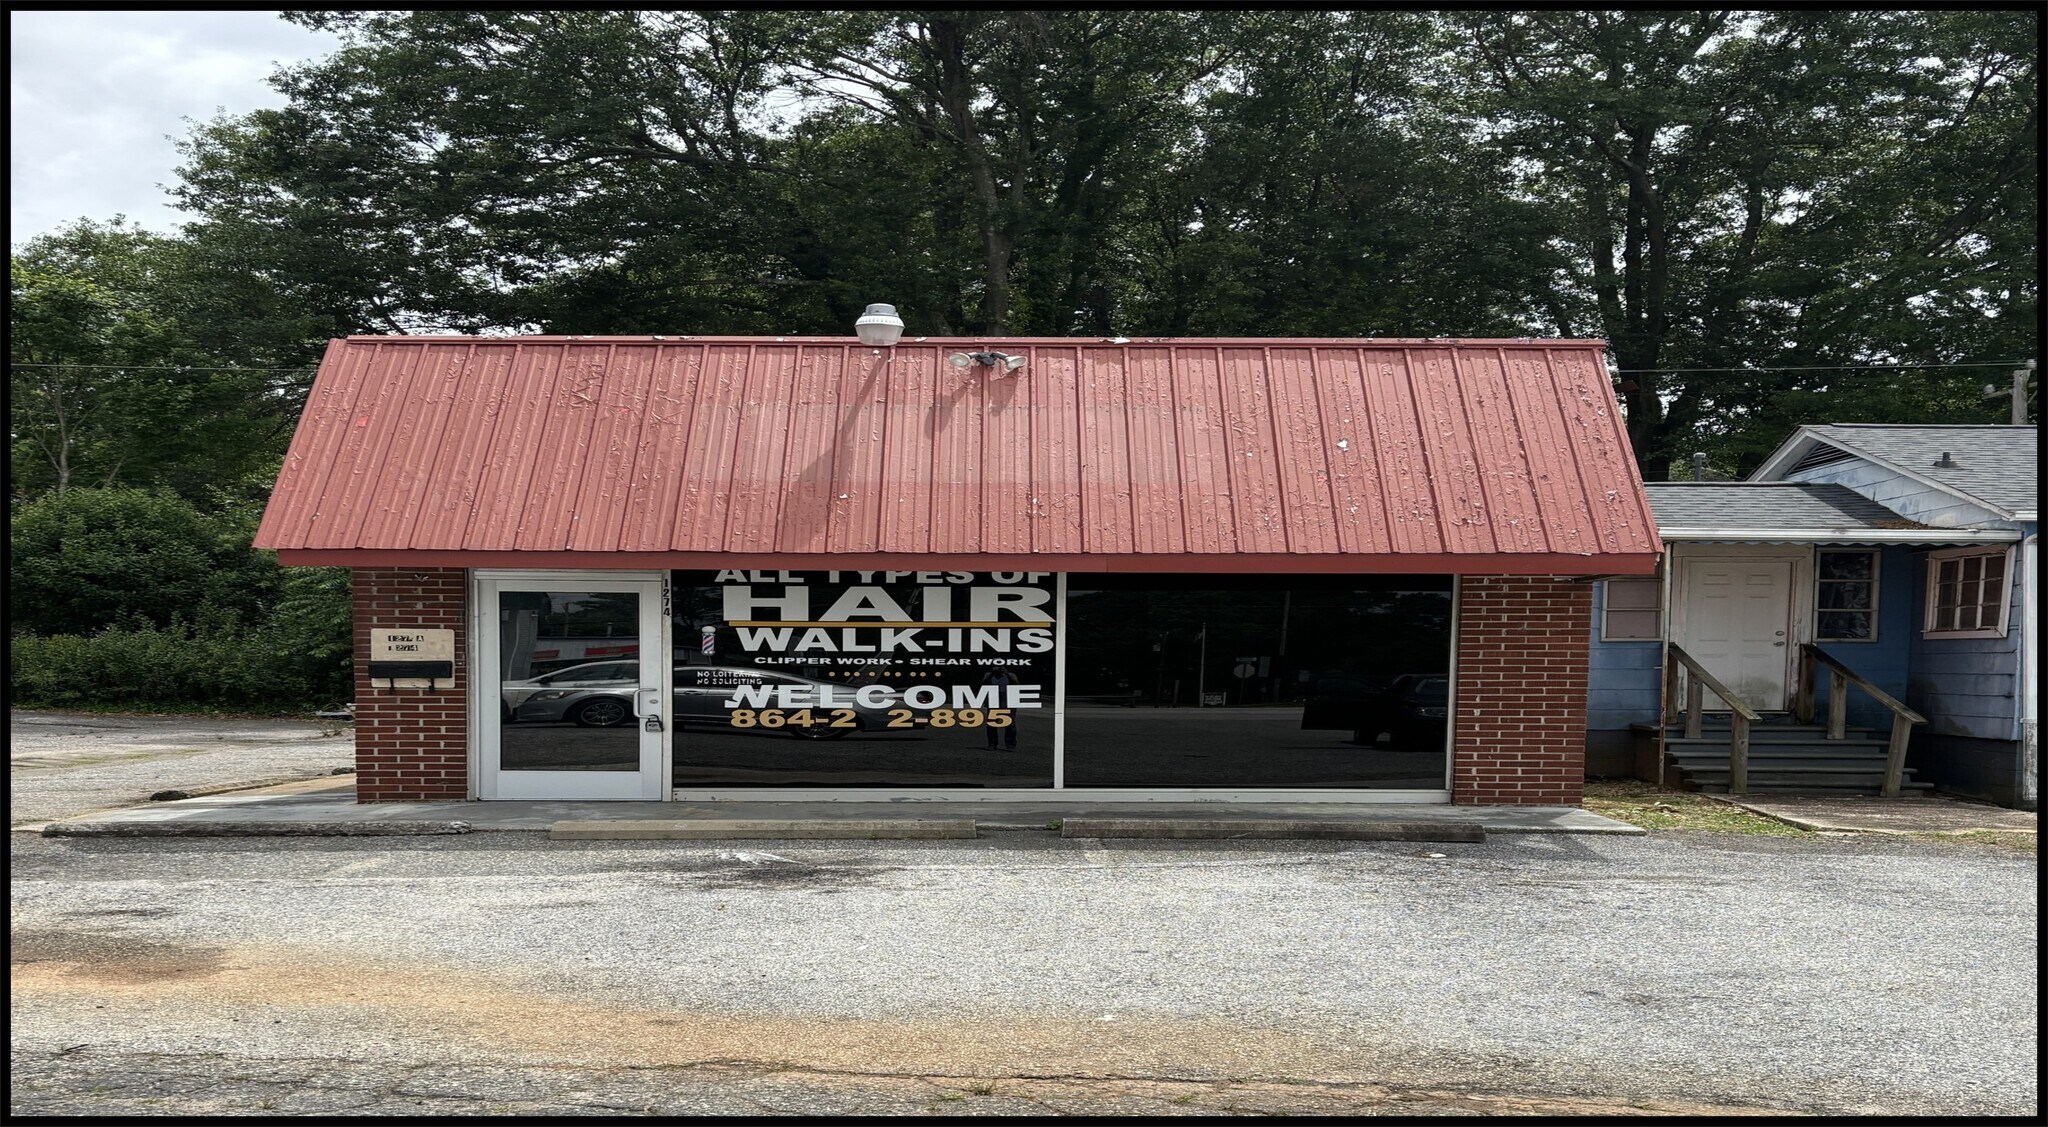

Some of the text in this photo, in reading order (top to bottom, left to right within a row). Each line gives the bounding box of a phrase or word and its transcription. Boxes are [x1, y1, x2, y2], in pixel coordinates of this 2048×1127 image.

[714, 570, 804, 583] ALL
[991, 571, 1051, 584] OF
[662, 578, 671, 617] 1274
[723, 586, 1056, 623] HAIR
[736, 628, 1054, 653] WALK-INS
[754, 656, 1032, 667] CLIPPER WORK SHEAR WORK
